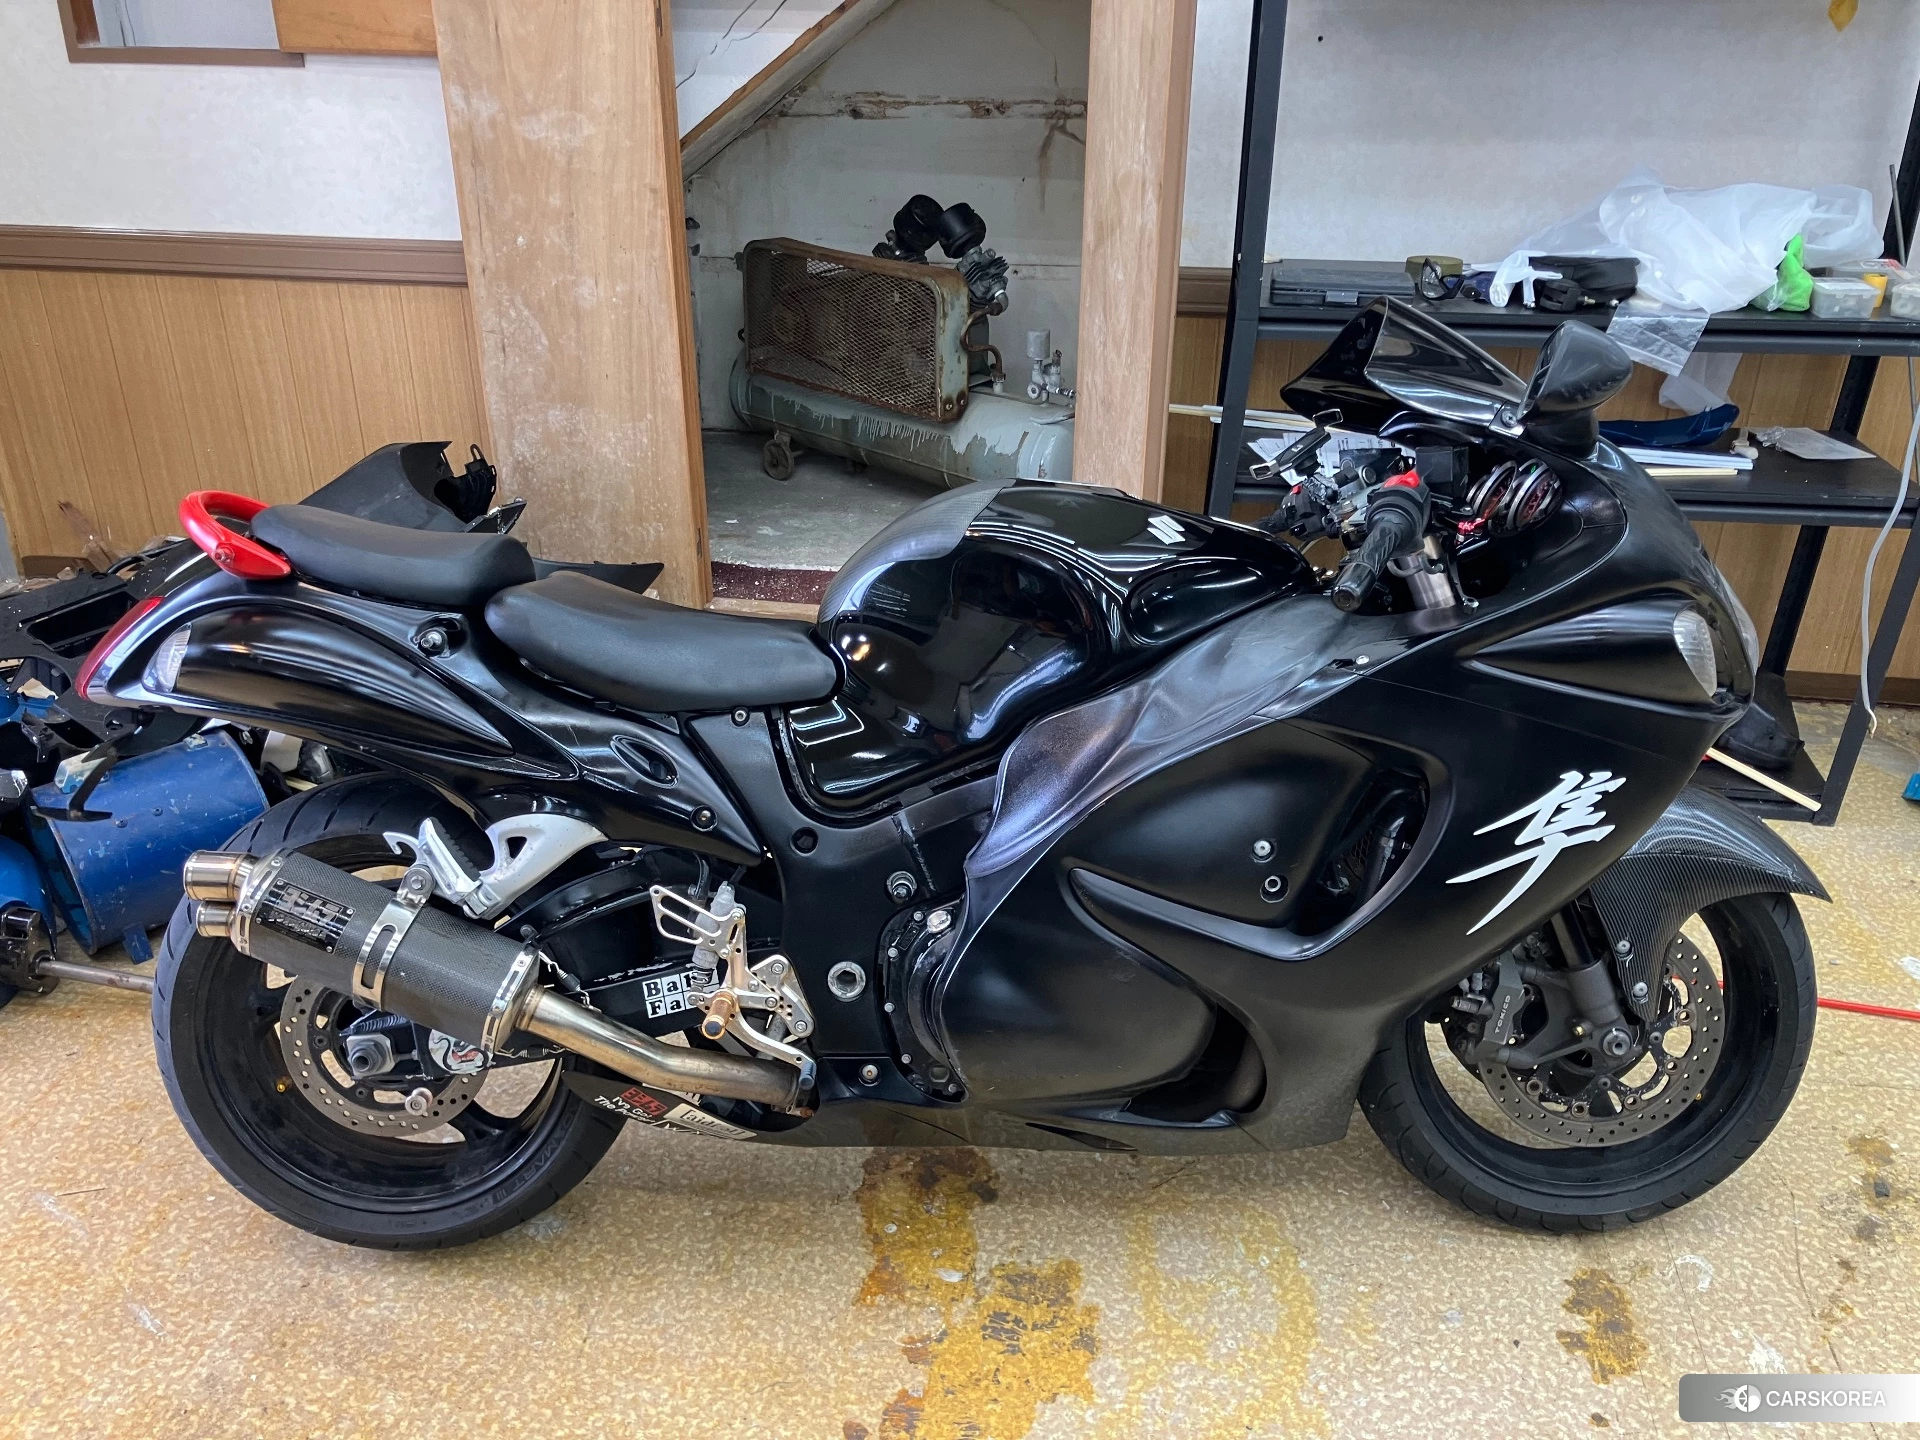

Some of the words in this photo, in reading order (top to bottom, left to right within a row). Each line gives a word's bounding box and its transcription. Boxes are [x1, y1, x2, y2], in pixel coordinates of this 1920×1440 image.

[1445, 770, 1627, 936] 隼
[1494, 995, 1511, 1034] TOKICO
[594, 1095, 616, 1110] The
